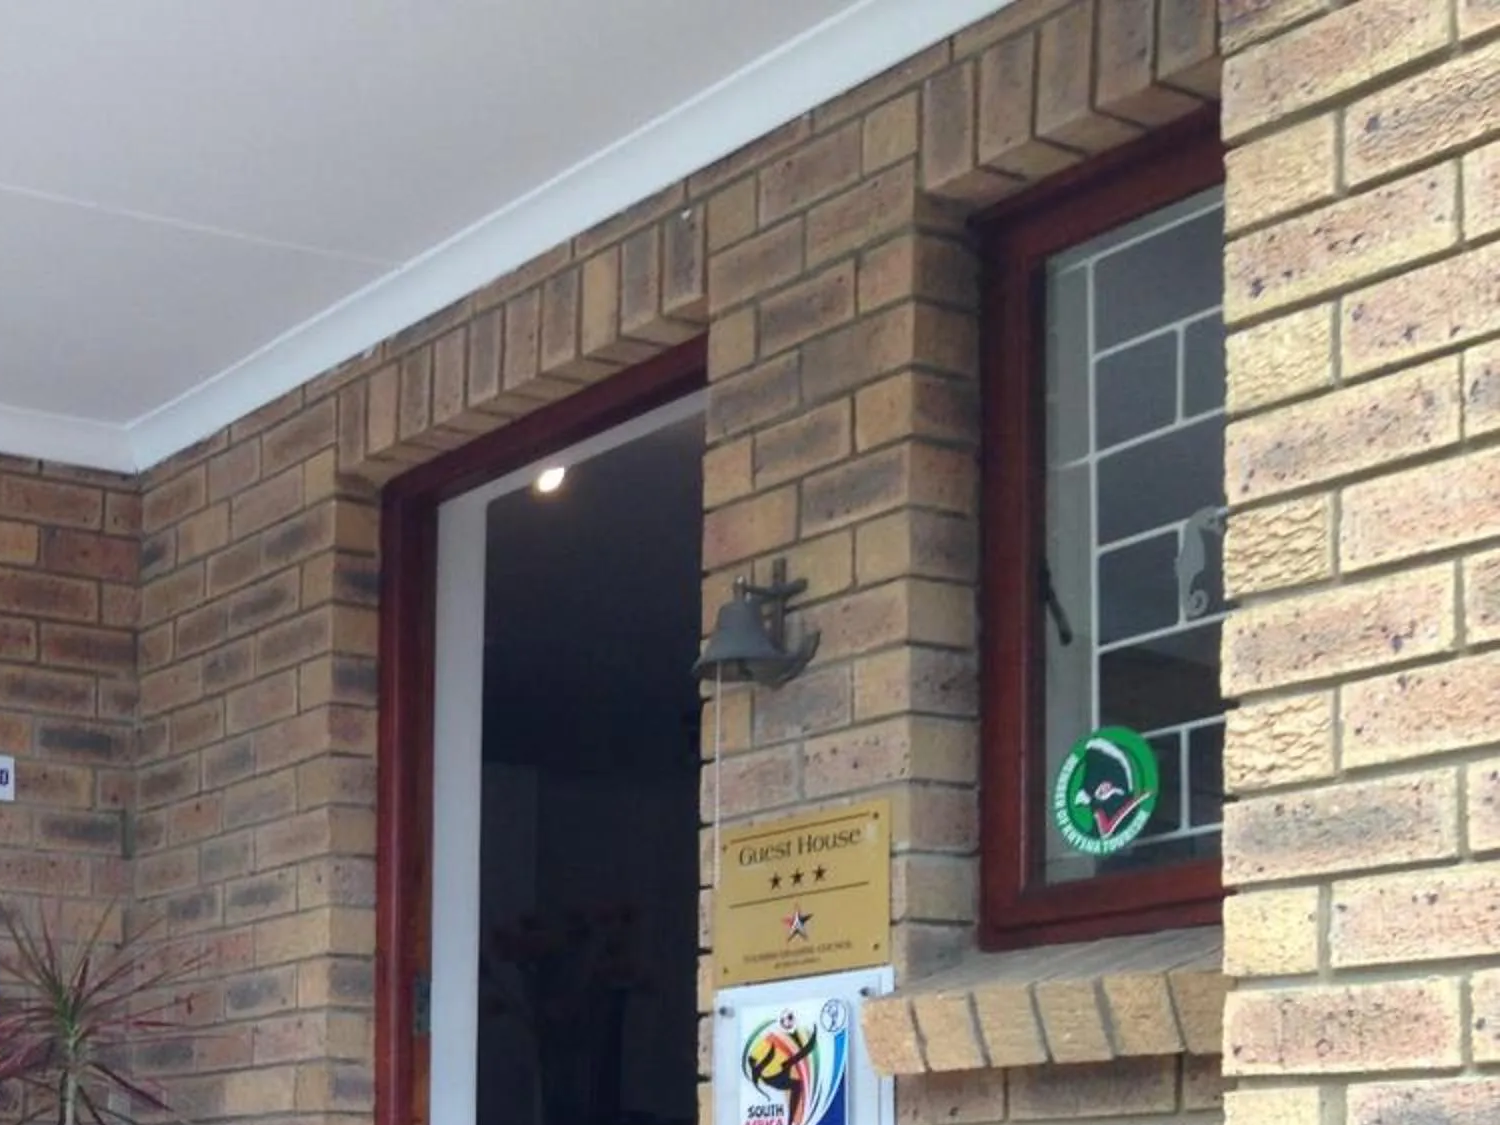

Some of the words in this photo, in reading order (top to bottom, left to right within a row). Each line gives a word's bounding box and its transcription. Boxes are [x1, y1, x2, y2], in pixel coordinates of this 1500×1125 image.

[738, 841, 791, 866] Guest
[798, 828, 862, 854] House
[747, 1104, 785, 1118] SOUTH
